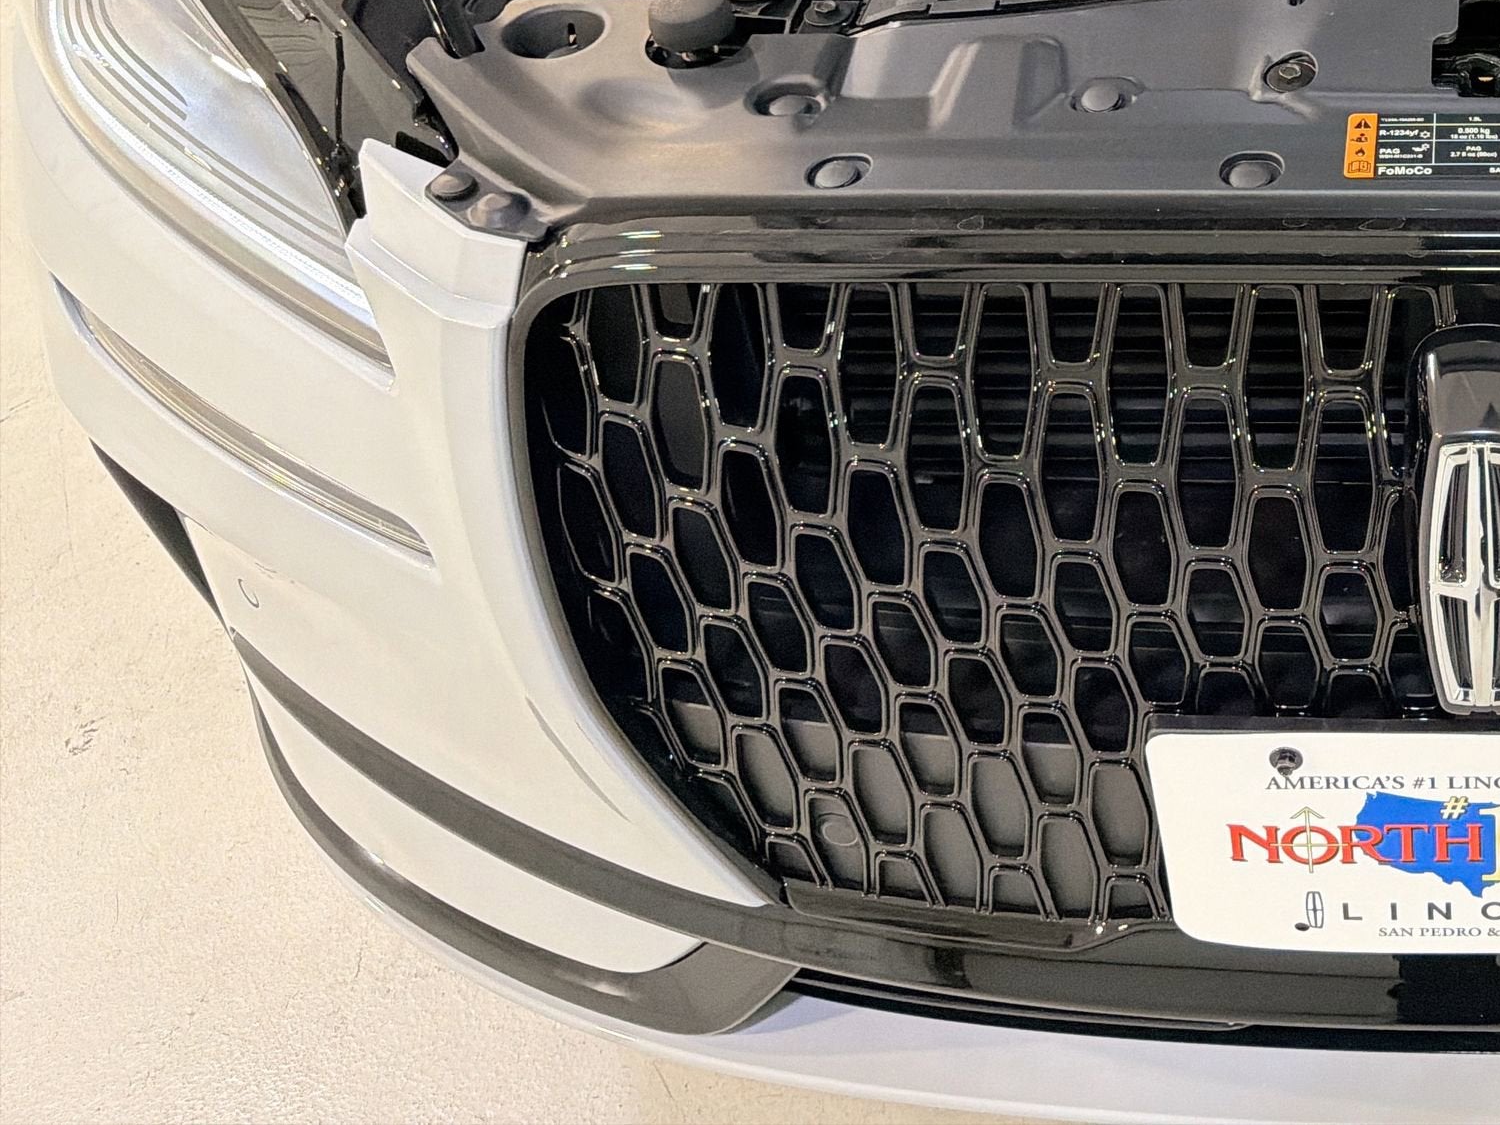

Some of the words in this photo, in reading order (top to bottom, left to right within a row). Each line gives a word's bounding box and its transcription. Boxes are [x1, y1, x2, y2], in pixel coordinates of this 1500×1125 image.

[1379, 129, 1419, 137] R-1234yf
[1480, 127, 1491, 135] kg
[1377, 166, 1432, 175] FoMoCo
[1265, 775, 1405, 790] AMERICA'S
[1413, 775, 1439, 790] #1
[1226, 823, 1484, 865] NORTH
[1378, 927, 1415, 938] SAN
[1419, 927, 1483, 938] PEDRO
